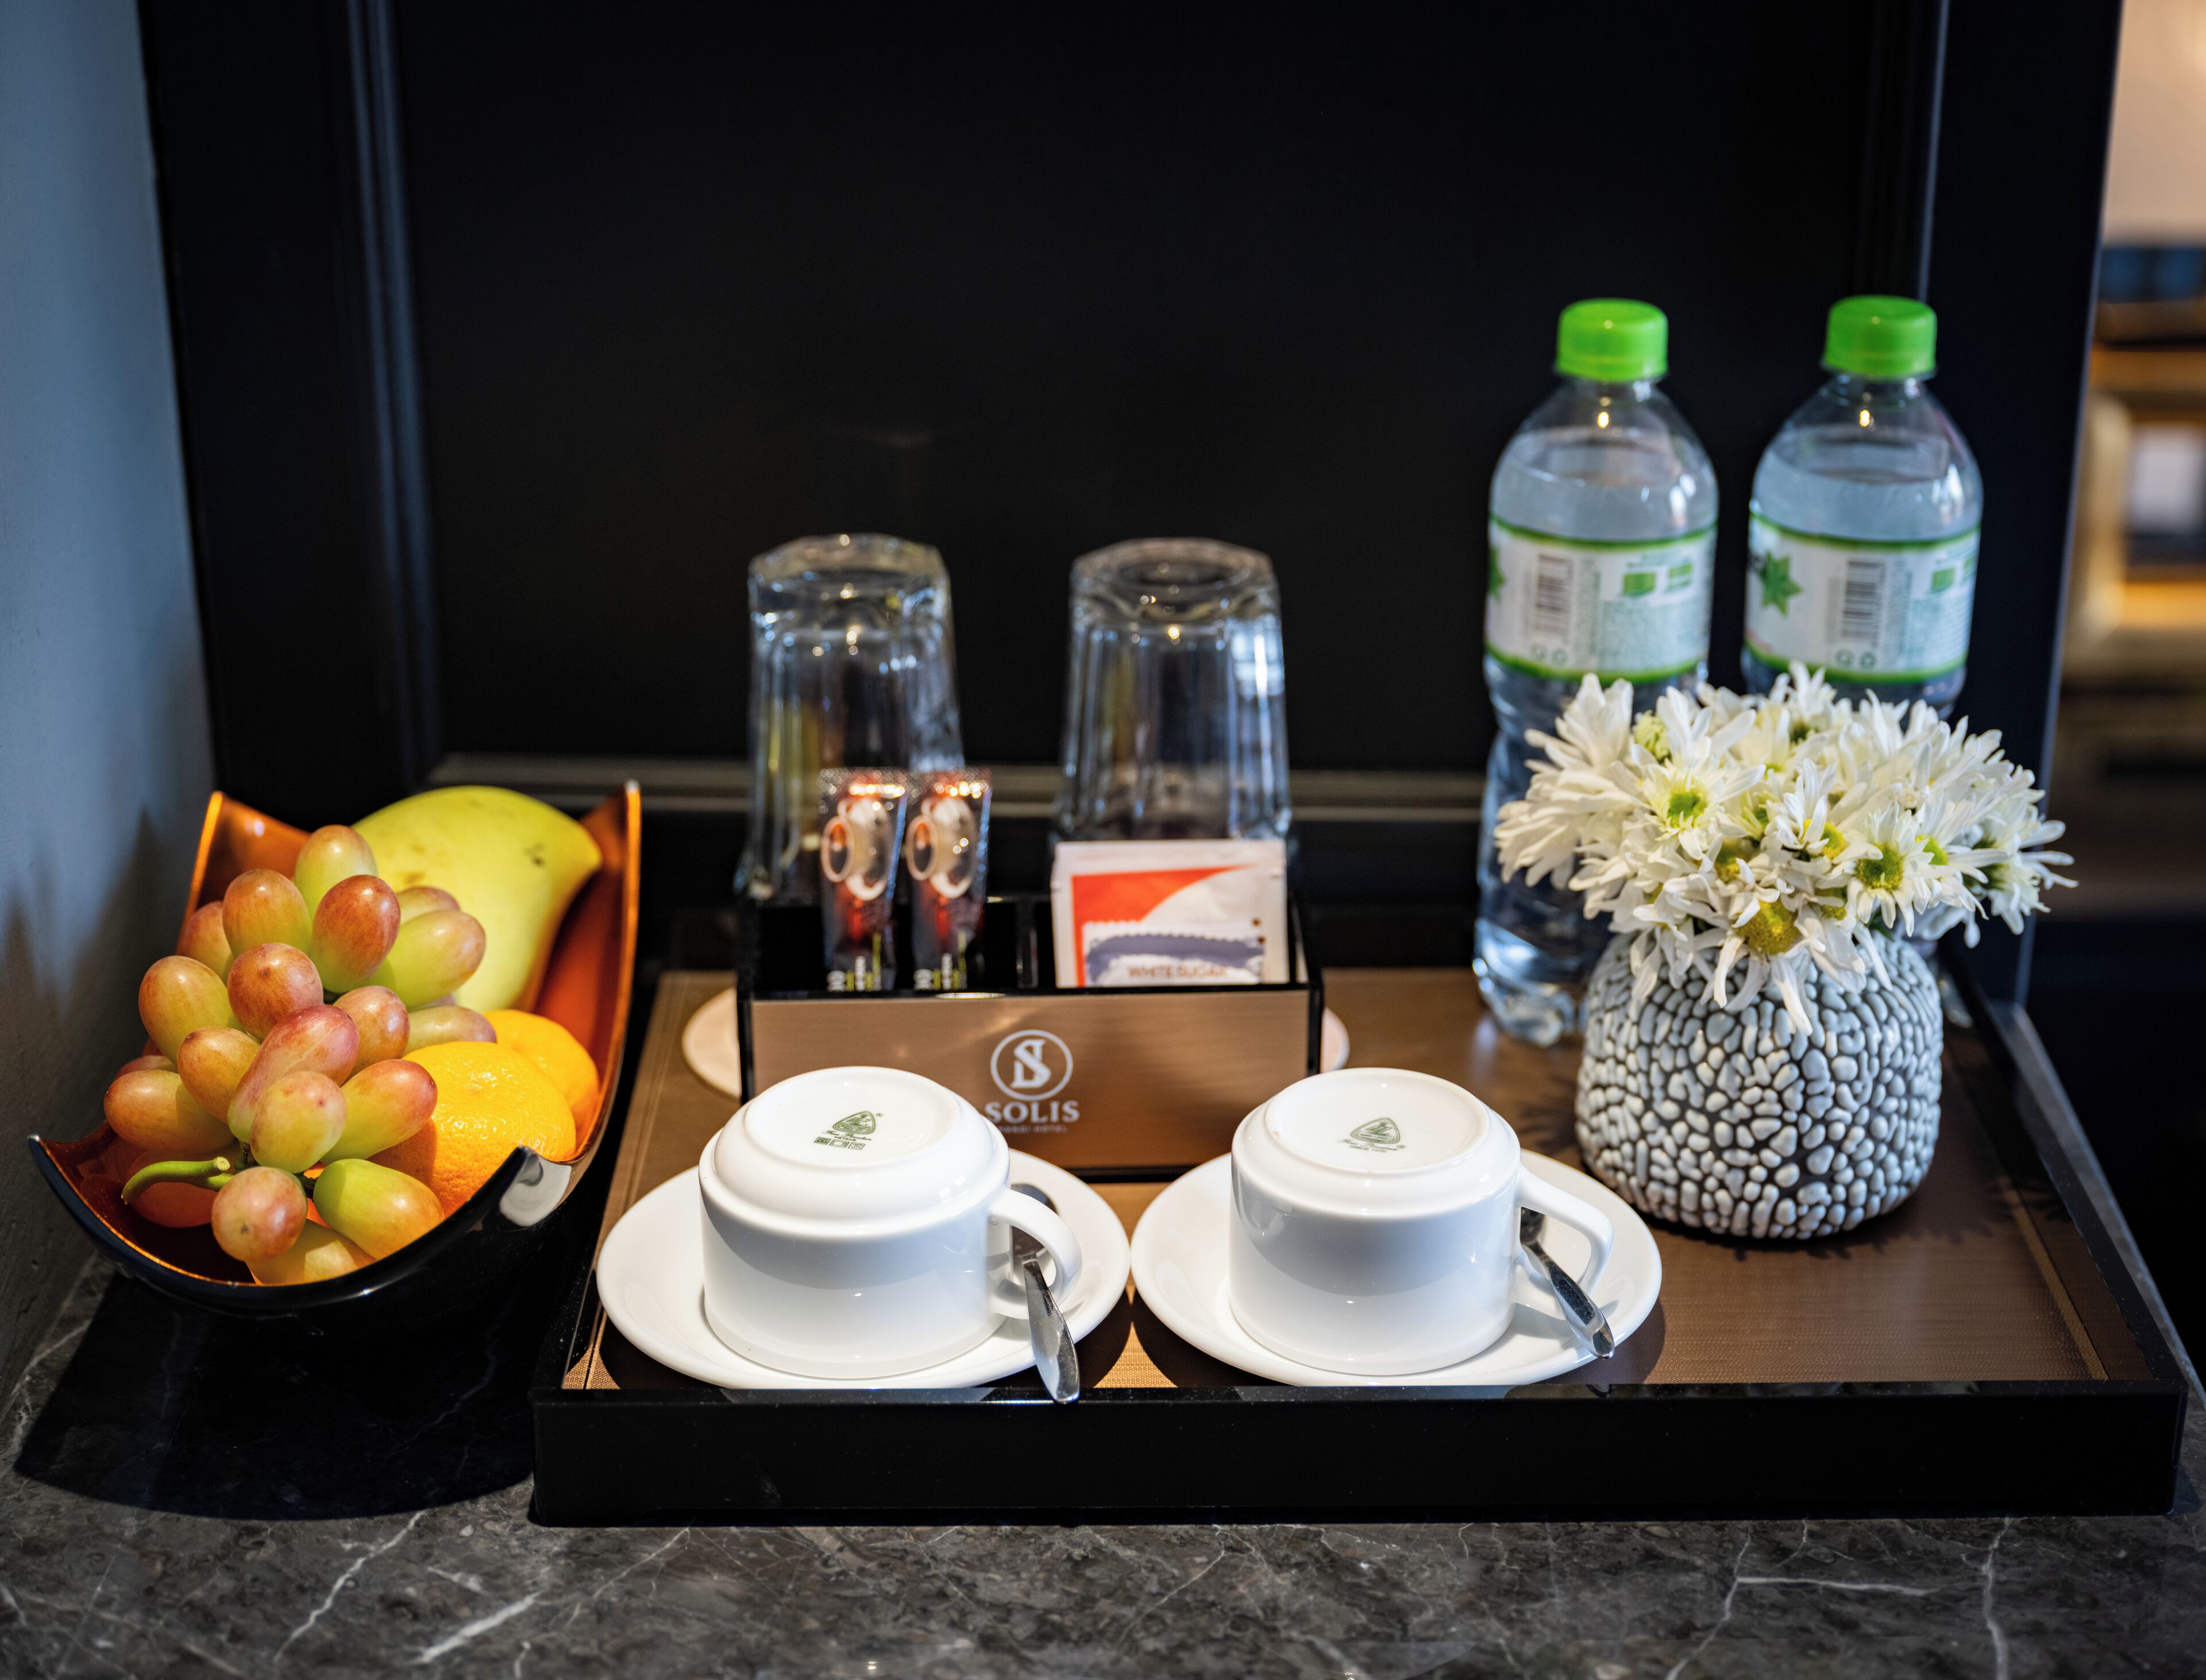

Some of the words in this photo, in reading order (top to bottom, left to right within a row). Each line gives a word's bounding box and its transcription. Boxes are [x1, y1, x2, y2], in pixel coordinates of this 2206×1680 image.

[1128, 965, 1171, 978] WHITE
[1178, 964, 1227, 978] SUGAR
[985, 1100, 1080, 1124] SOLIS
